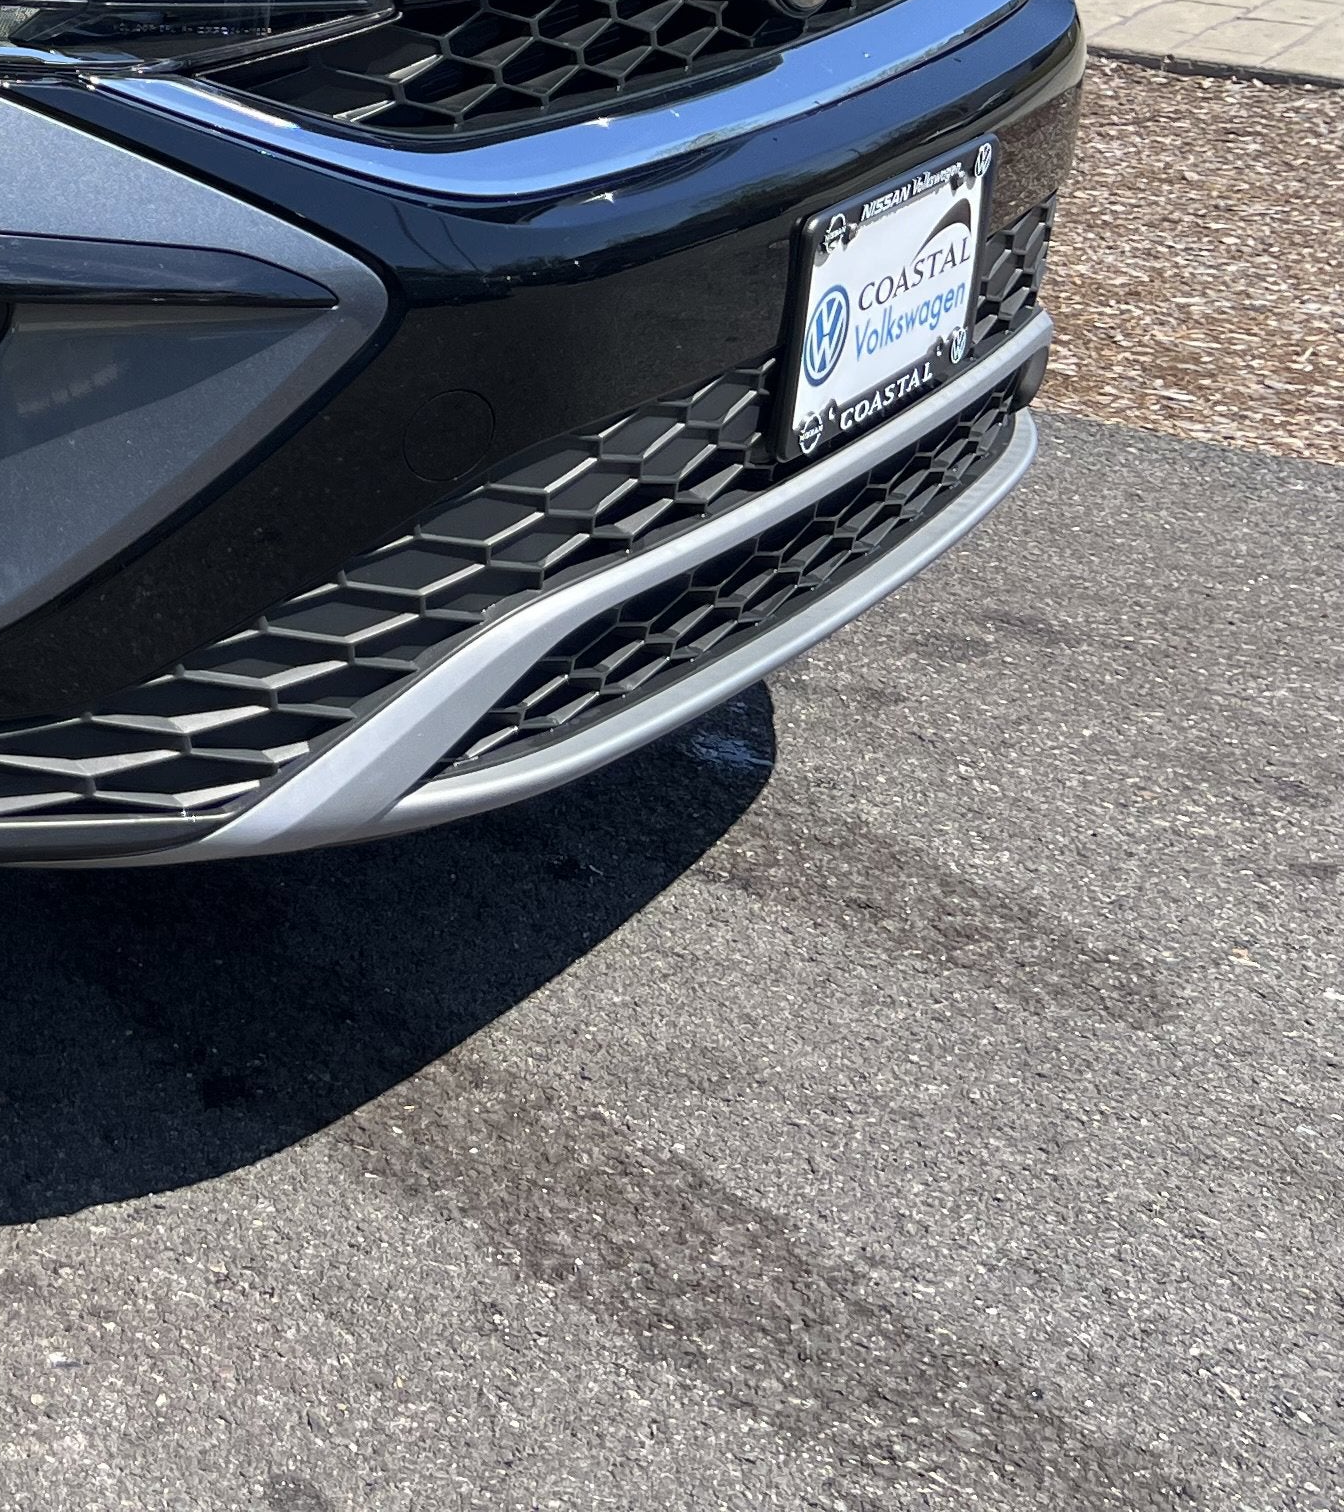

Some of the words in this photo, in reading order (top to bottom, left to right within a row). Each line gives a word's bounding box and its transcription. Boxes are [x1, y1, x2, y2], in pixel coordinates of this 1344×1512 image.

[861, 184, 912, 222] NISSAN
[858, 235, 971, 311] COASTAL
[855, 282, 966, 362] Volkswagen
[840, 361, 933, 430] COASTAL
